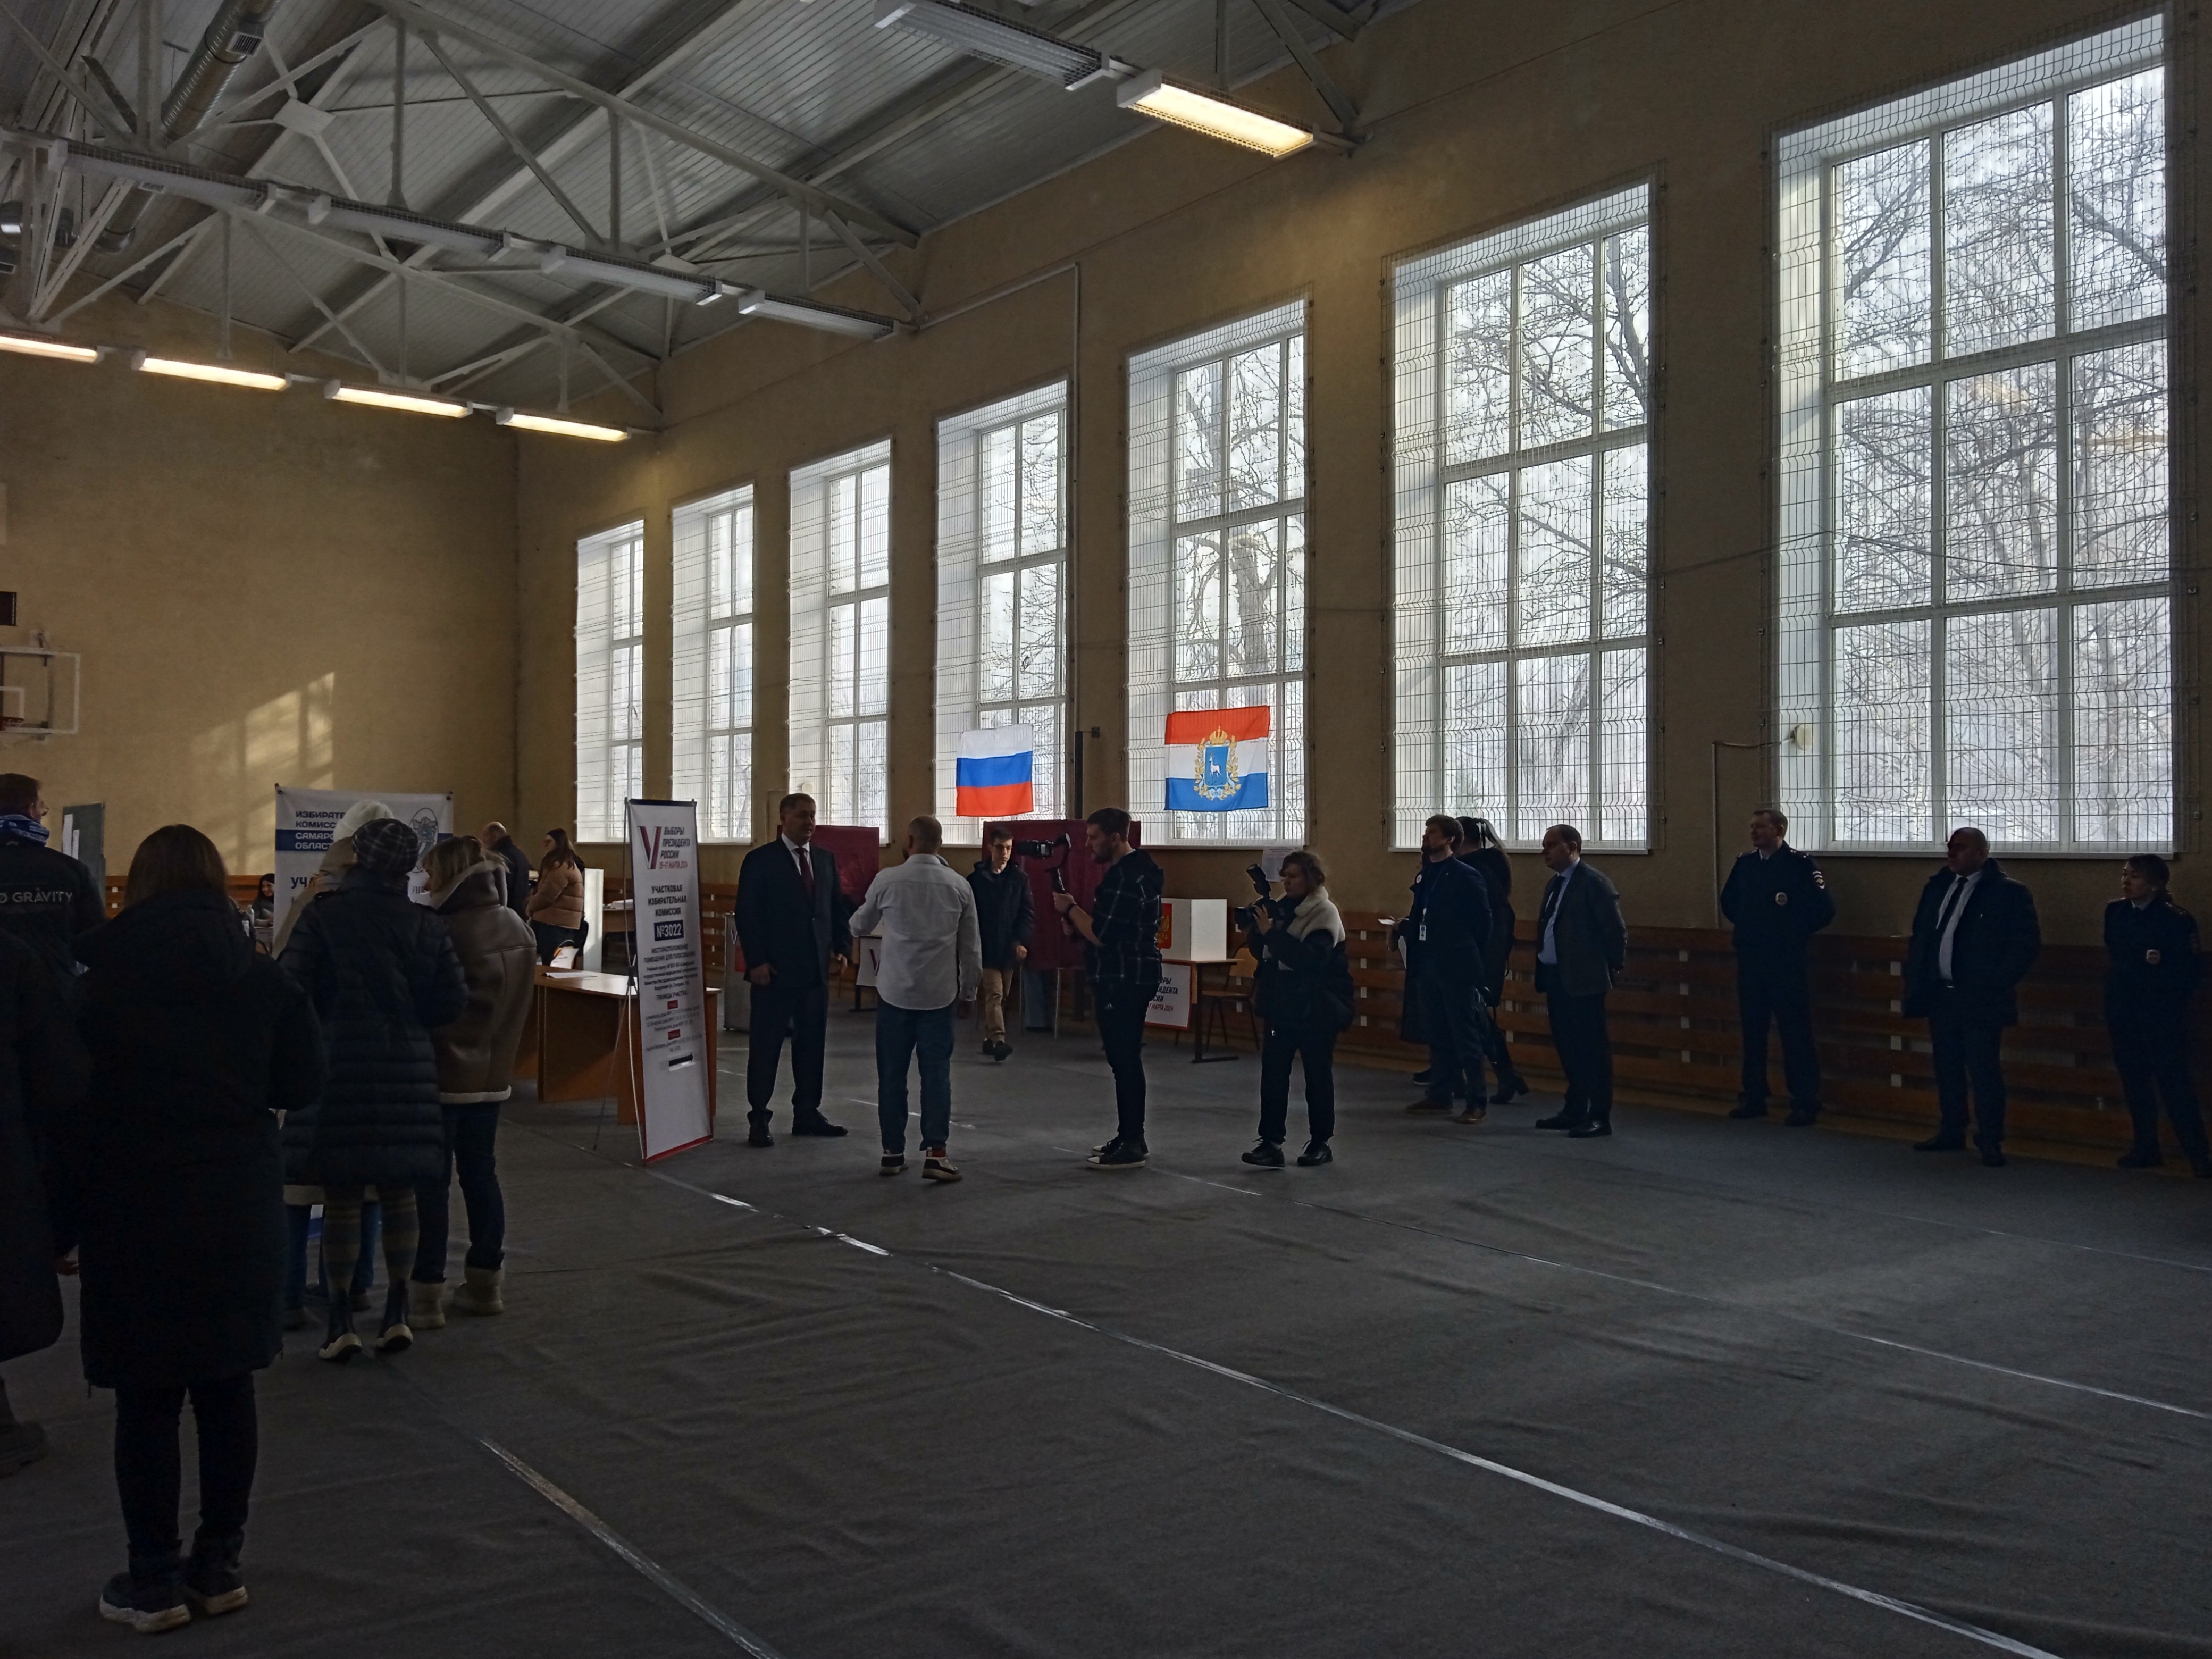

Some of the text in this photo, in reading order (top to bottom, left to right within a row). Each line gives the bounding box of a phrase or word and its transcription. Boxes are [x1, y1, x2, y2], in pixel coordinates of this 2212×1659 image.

[664, 826, 684, 835] ВЫБОРЫ
[662, 838, 690, 848] ПРЕЗИДЕНТА
[651, 885, 682, 893] УЧАСТКОВАЯ
[648, 895, 686, 906] ИЗБИРАТЕЛЬНАЯ
[655, 907, 681, 916] КОМИССИЯ
[656, 923, 682, 938] №3022
[1158, 986, 1178, 994] ИДЕНТА
